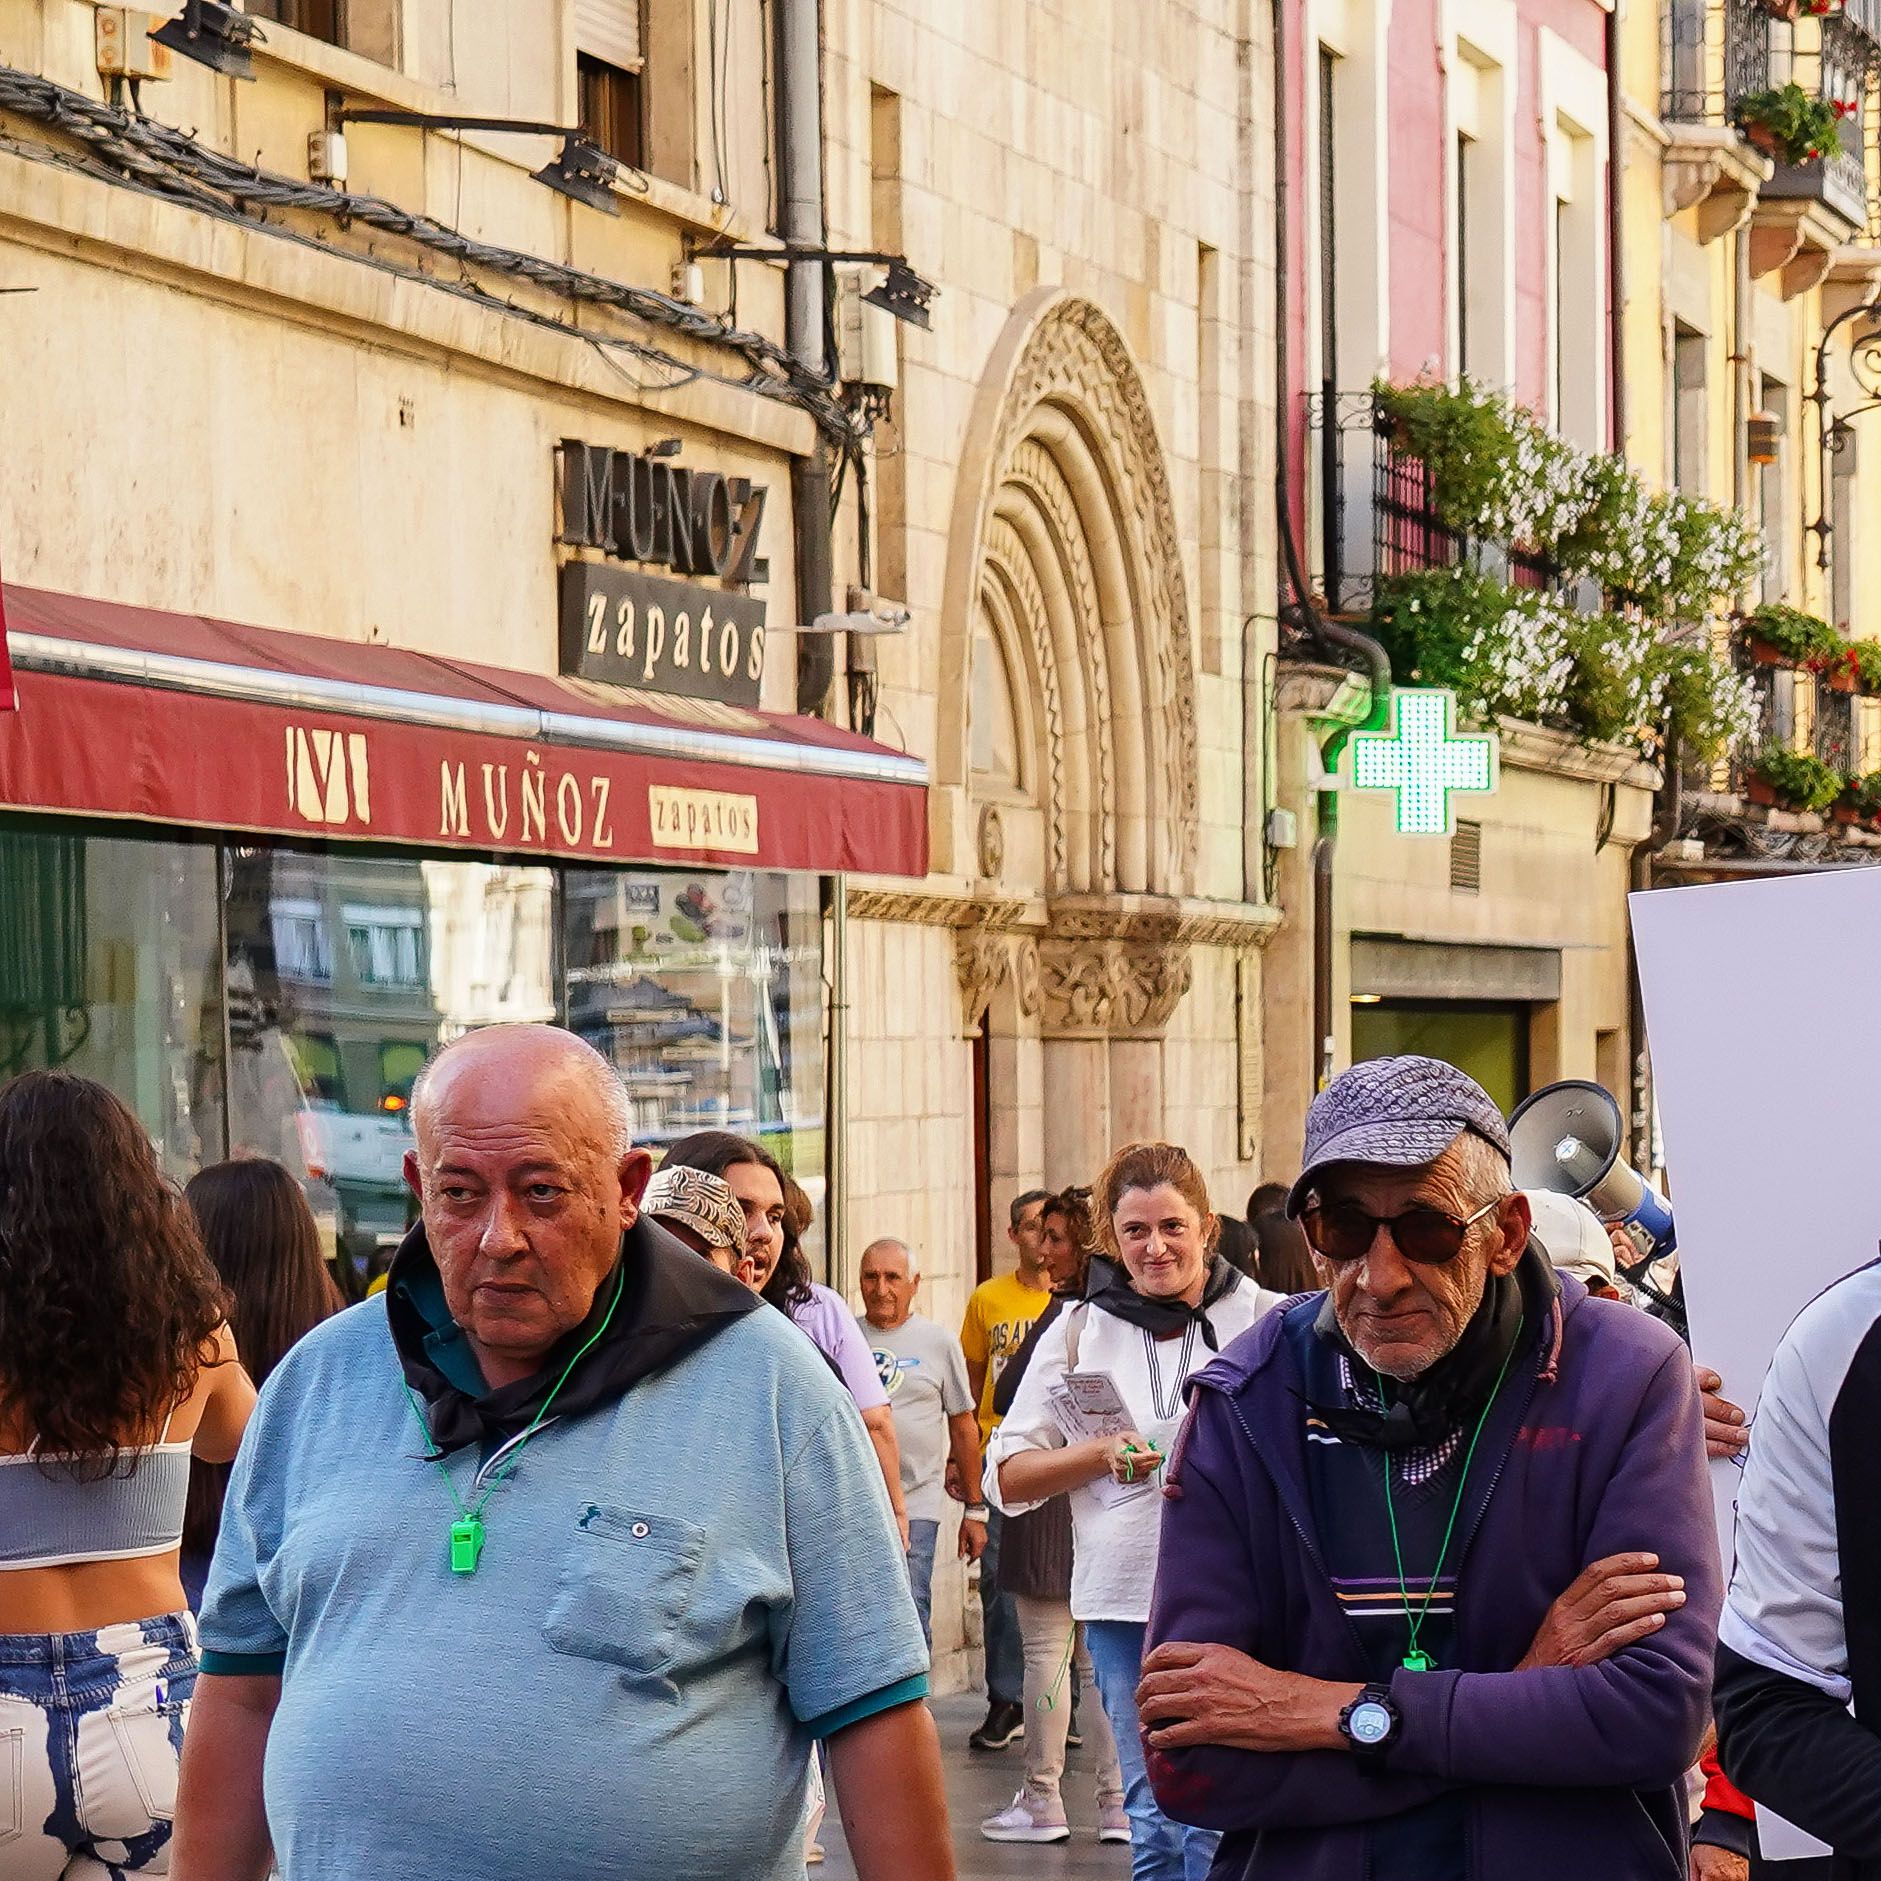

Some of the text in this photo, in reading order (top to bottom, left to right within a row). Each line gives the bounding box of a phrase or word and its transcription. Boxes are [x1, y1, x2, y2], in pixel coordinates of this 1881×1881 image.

[587, 594, 765, 681] zapatos
[440, 750, 613, 848] MUÑOZ
[656, 798, 752, 842] zapatos
